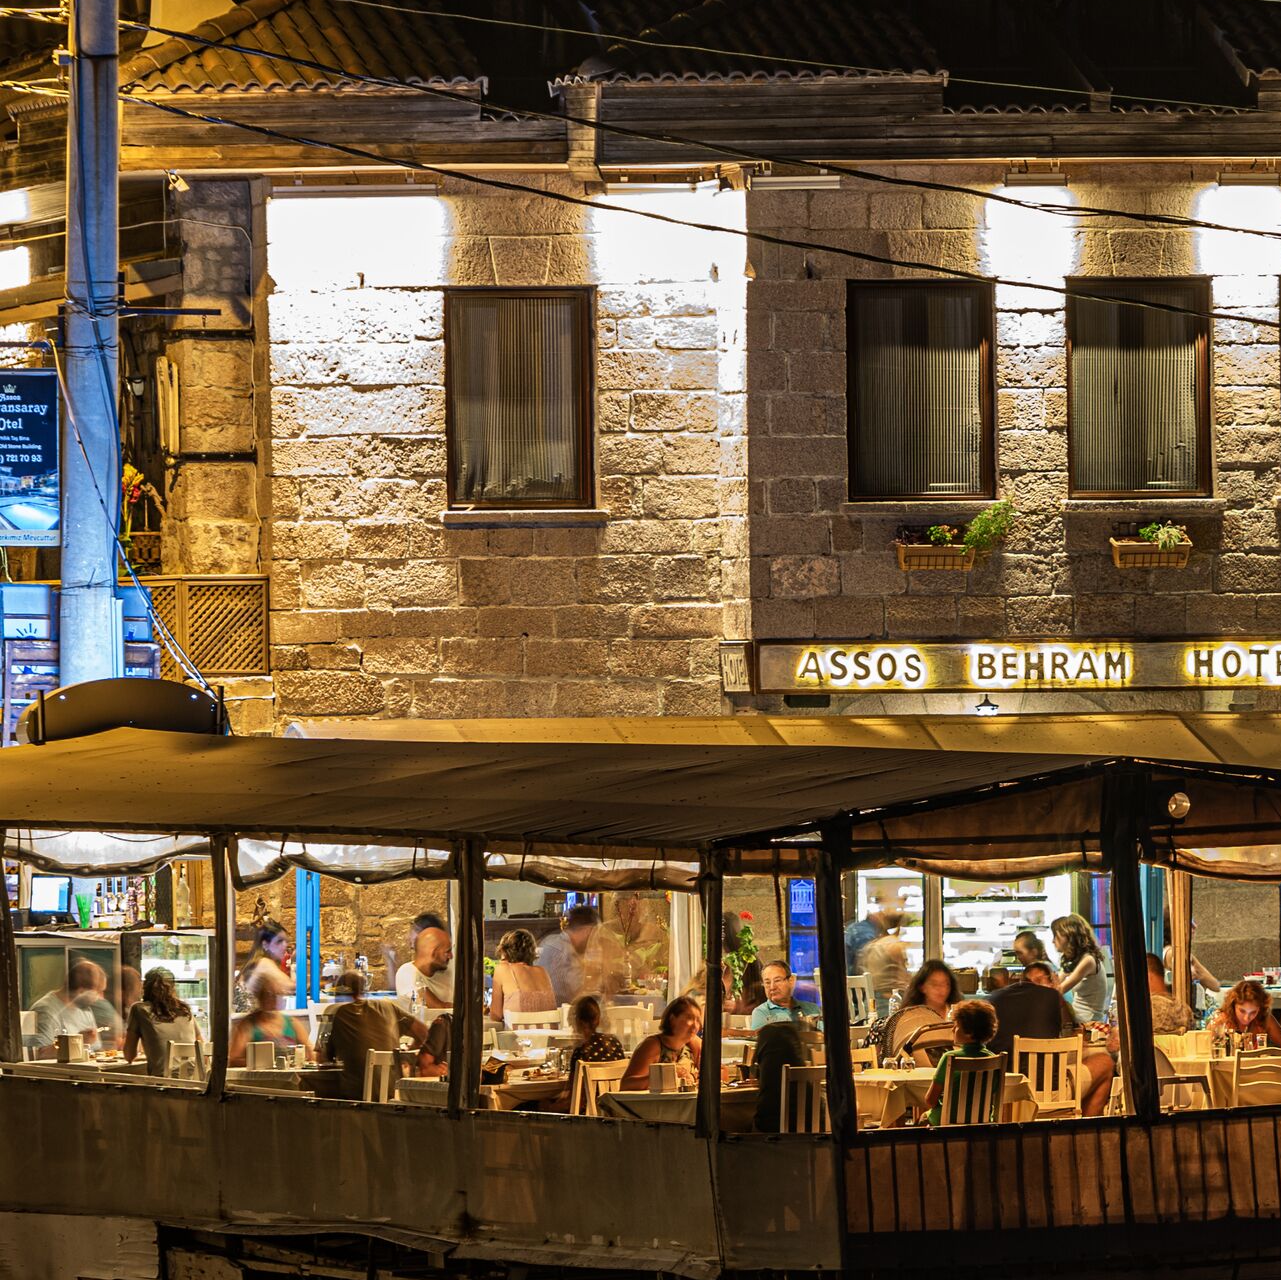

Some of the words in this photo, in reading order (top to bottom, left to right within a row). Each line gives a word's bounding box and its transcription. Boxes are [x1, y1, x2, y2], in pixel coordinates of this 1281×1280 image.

[0, 404, 48, 416] ansaray
[6, 454, 18, 462] 721
[20, 454, 30, 462] 70
[31, 454, 42, 462] 93
[799, 650, 922, 683] ASSOS
[977, 651, 1127, 681] BEHRAM
